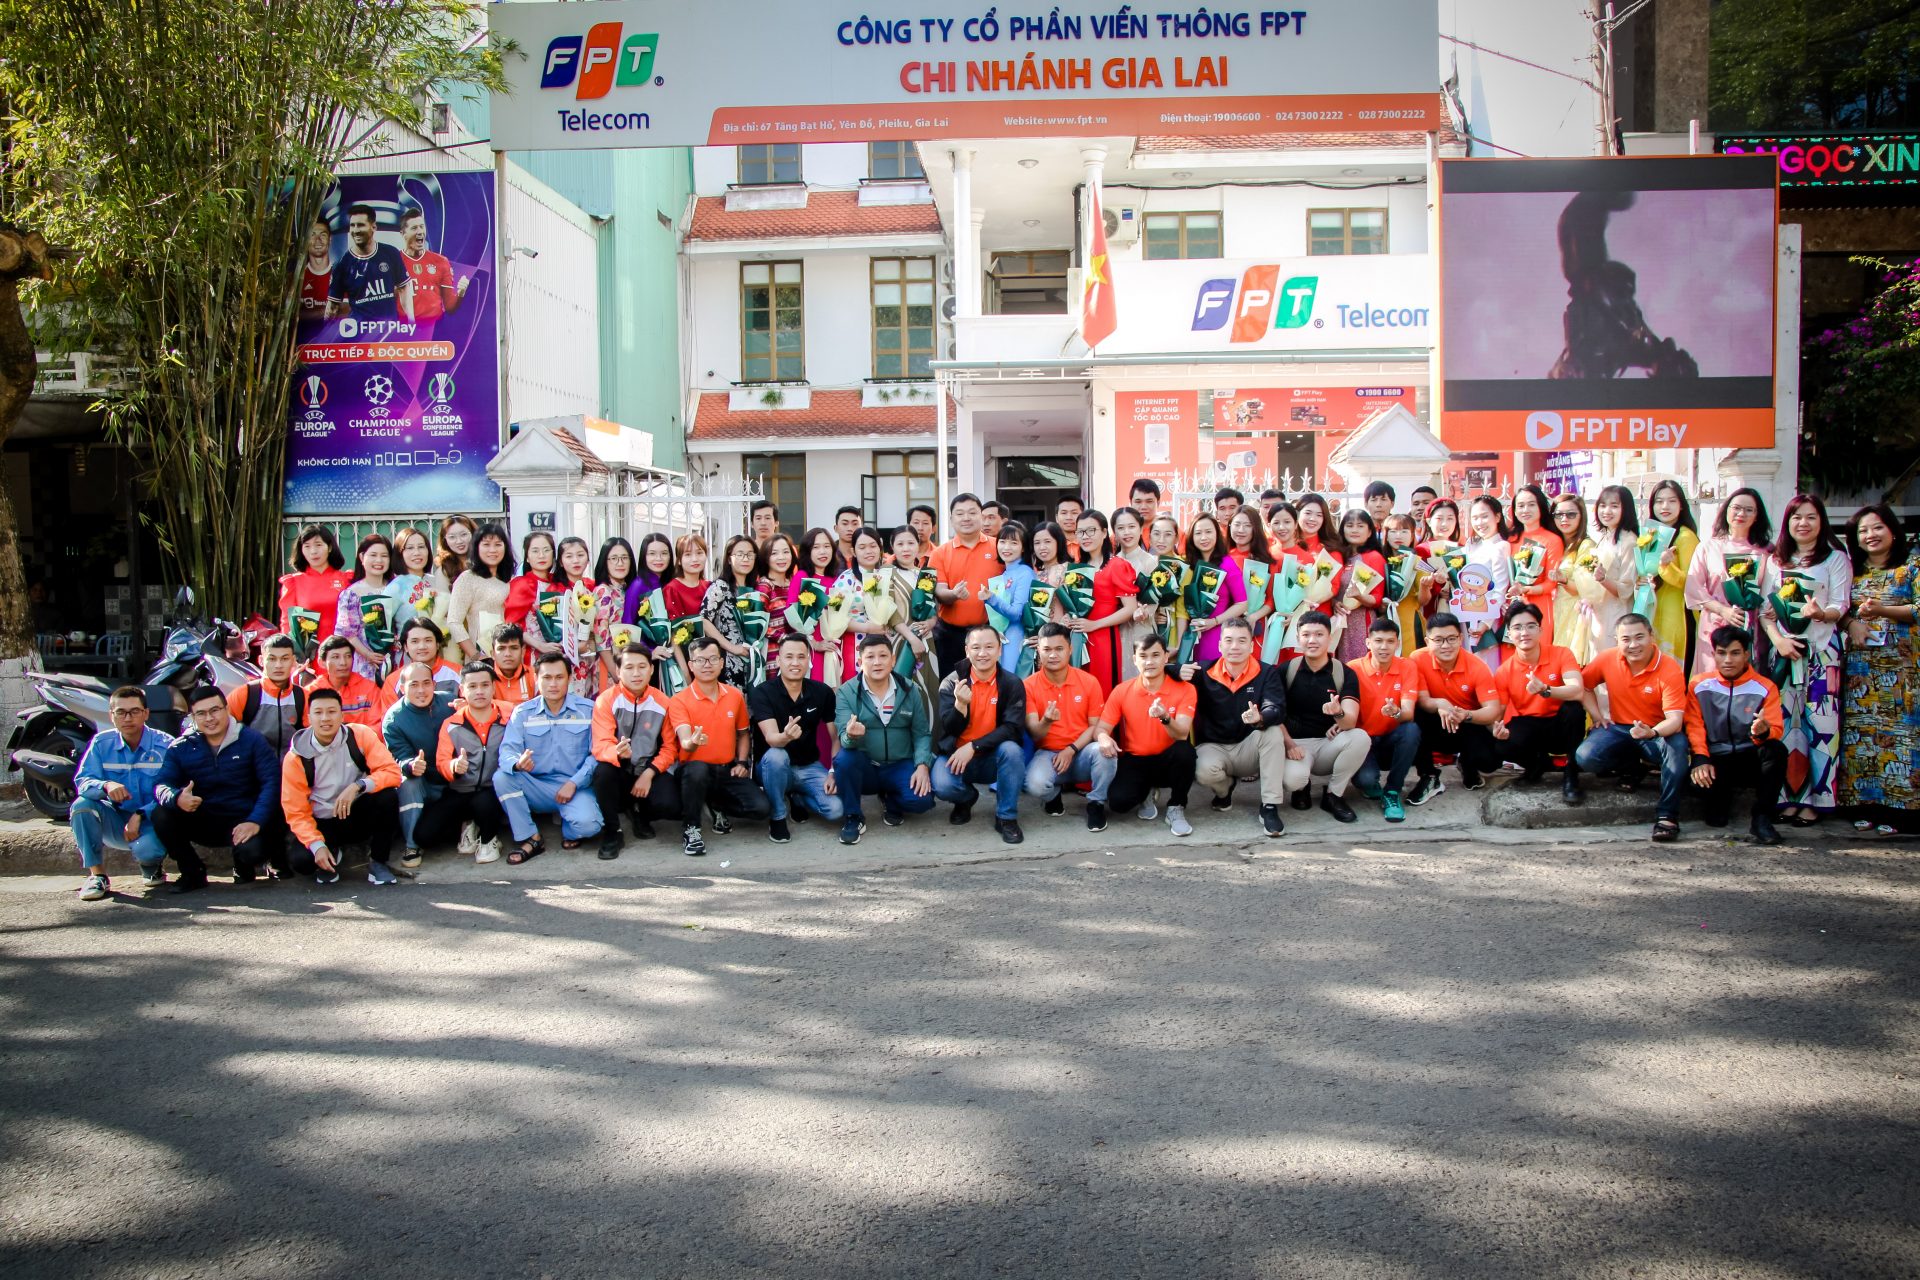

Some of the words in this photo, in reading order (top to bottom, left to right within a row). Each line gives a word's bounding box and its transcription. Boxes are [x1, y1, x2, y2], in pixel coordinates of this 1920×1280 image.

[837, 14, 912, 46] CÔNG
[919, 18, 954, 43] TY
[963, 6, 999, 43] CỔ
[1009, 6, 1082, 42] PHẦN
[1090, 4, 1147, 41] VIỄN
[1156, 6, 1250, 38] THÔNG
[1260, 11, 1307, 36] FPT
[899, 60, 956, 93] CHI
[966, 52, 1092, 92] NHÁNH
[1102, 57, 1163, 88] GIA
[1174, 55, 1228, 87] LAI
[557, 108, 650, 131] Telecom
[1160, 112, 1182, 124] Điện
[1213, 112, 1261, 121] 19006600
[1275, 112, 1293, 121] 024
[1358, 110, 1377, 120] 028
[1378, 110, 1401, 119] 7300
[1402, 109, 1426, 119] 2222
[760, 122, 772, 131] 67
[800, 121, 817, 133] Bạt
[839, 120, 857, 129] Yên
[878, 118, 913, 129] Pleiku,
[915, 118, 931, 128] Gia
[934, 117, 949, 127] Lai
[360, 321, 386, 335] FPT
[388, 319, 417, 336] Play
[305, 347, 336, 361] TRỰC
[338, 345, 364, 358] TIẾP
[366, 349, 375, 358] &
[378, 345, 404, 359] ĐỘC
[305, 410, 326, 421] UEFA
[368, 407, 391, 419] UEFA
[432, 404, 452, 415] UEFA
[295, 421, 337, 432] EUROPA
[348, 418, 412, 428] CHAMPIONS
[422, 415, 463, 425] EUROPA
[360, 428, 401, 437] LEAGUE
[1569, 417, 1622, 442] FPT
[1629, 417, 1688, 447] Play
[297, 457, 330, 467] KHÔNG
[331, 455, 350, 466] GIỚI
[352, 458, 372, 467] HẠN
[532, 512, 551, 527] 67
